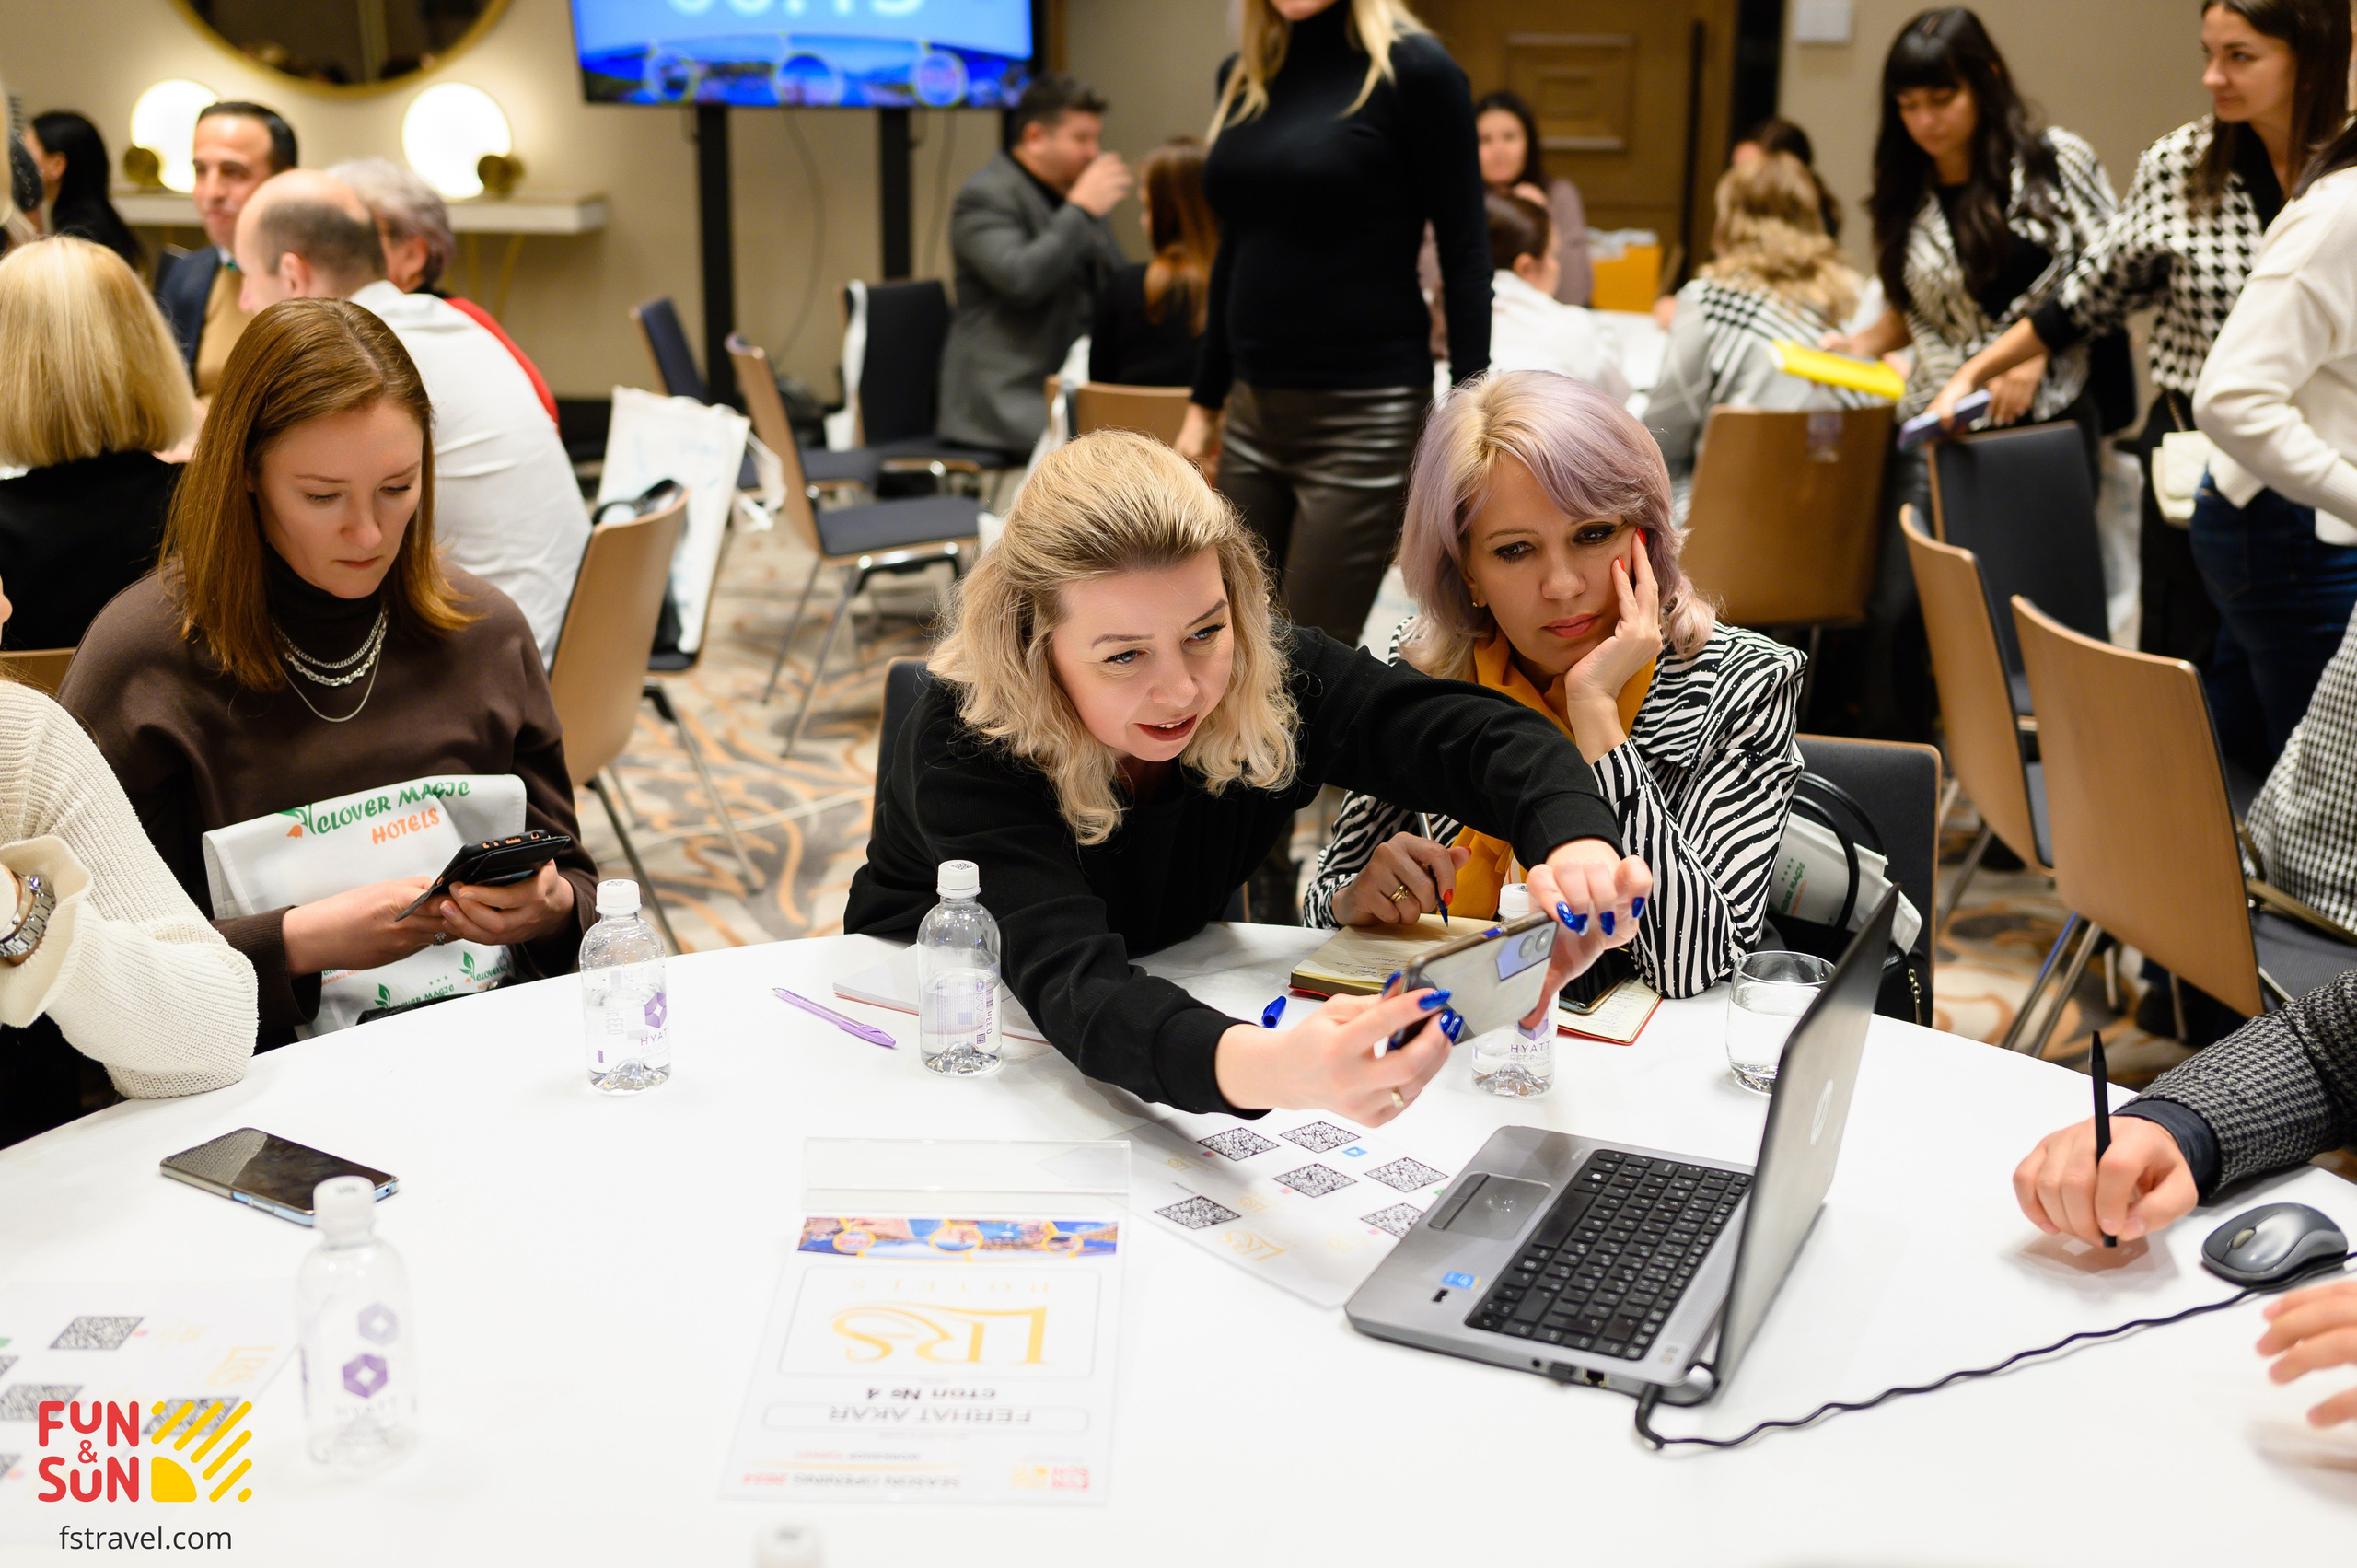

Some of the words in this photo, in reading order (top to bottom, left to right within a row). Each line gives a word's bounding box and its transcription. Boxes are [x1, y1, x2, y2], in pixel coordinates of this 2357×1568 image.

[317, 796, 392, 835] CLOVER
[371, 807, 440, 845] HOTELS
[1510, 1040, 1550, 1053] HYATT
[830, 1300, 1053, 1365] LRS
[829, 1405, 910, 1423] AKAR
[918, 1406, 1032, 1423] FERHAT
